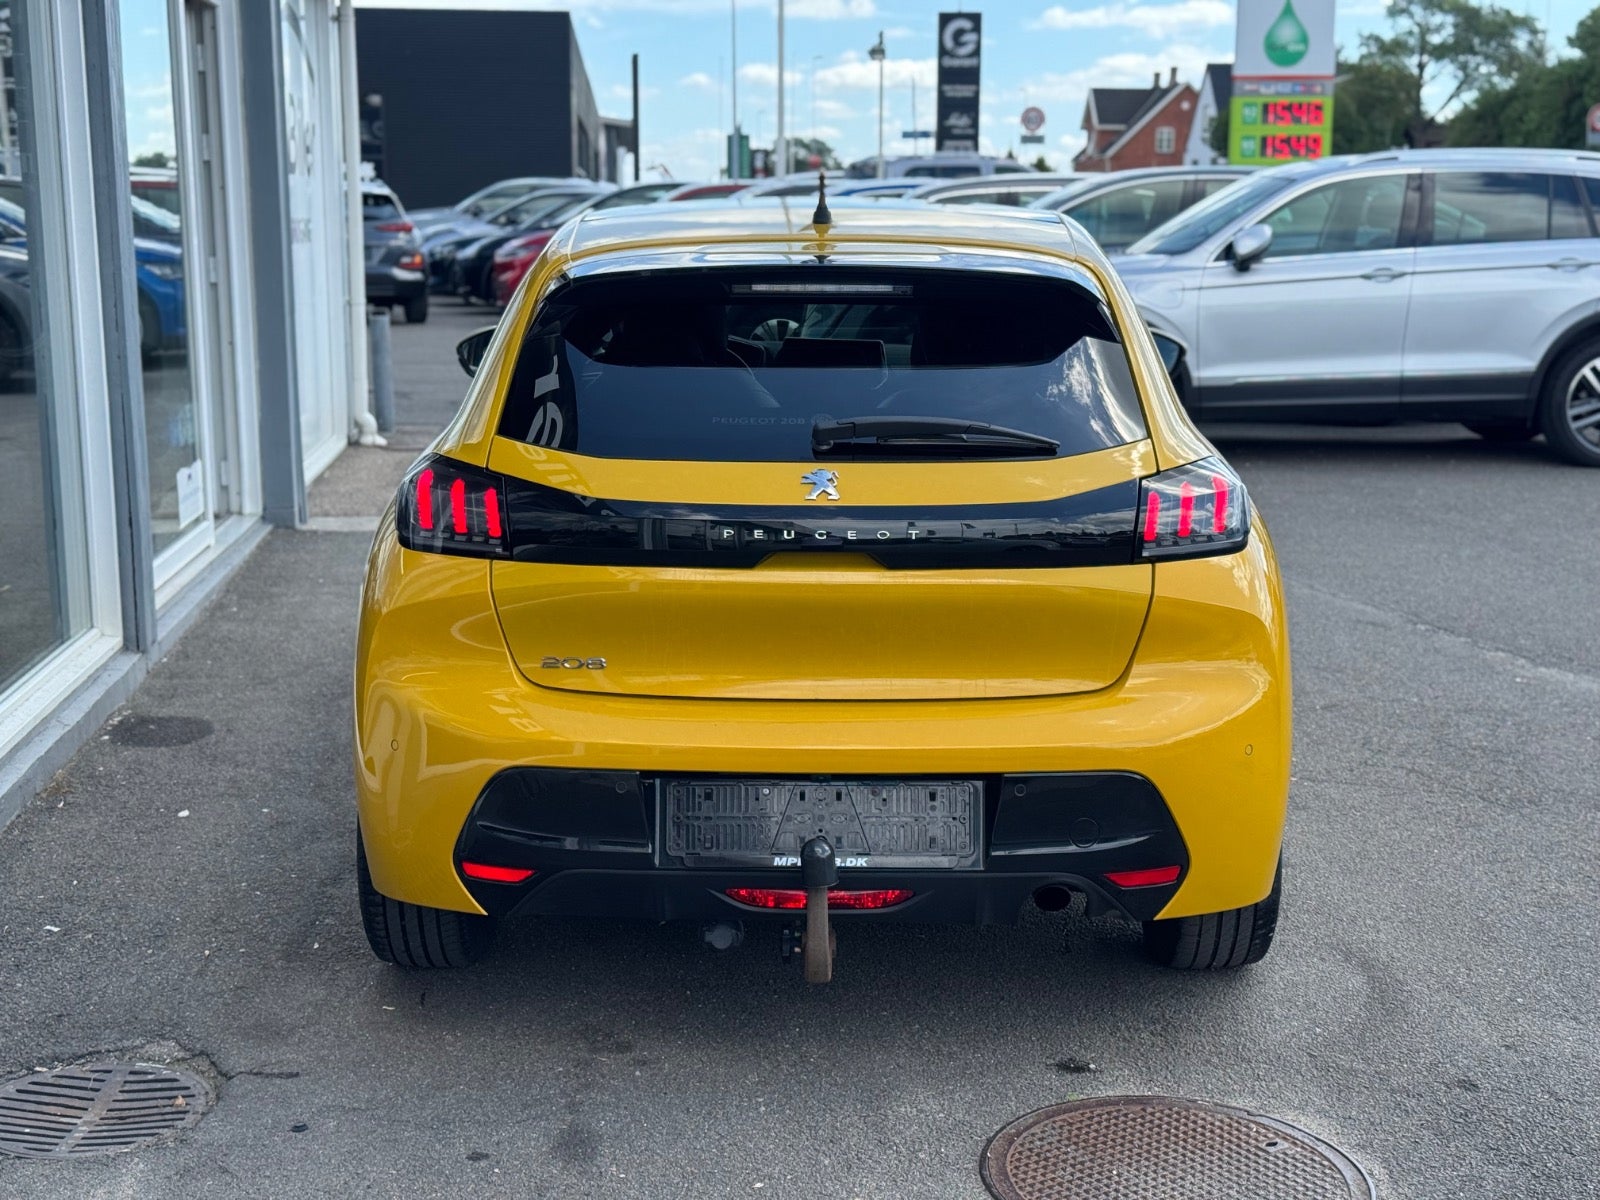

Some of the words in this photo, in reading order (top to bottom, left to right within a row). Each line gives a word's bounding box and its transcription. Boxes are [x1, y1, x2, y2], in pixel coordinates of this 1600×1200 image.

[942, 17, 979, 57] G
[712, 416, 775, 425] PEUGEOT
[723, 529, 920, 540] PEUGEOT
[541, 656, 607, 670] 208
